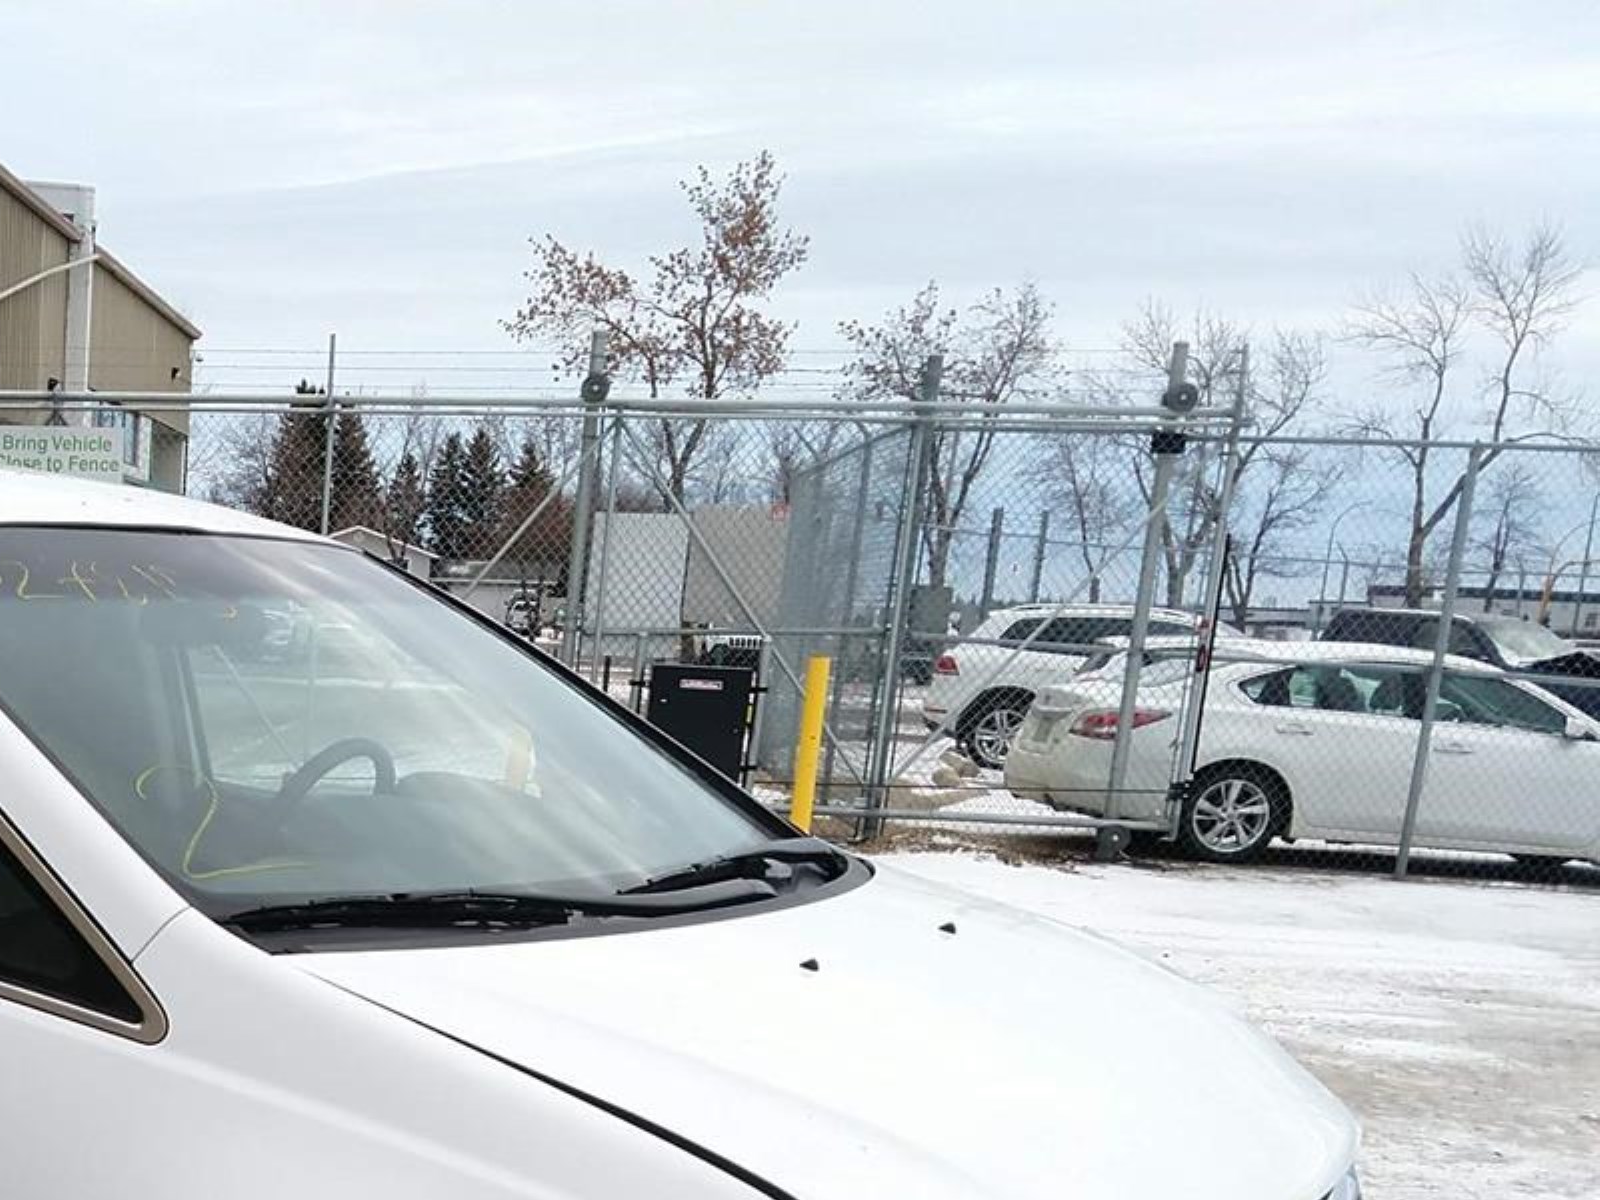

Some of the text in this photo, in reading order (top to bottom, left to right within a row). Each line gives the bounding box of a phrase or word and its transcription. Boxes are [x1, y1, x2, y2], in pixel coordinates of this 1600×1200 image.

[2, 434, 113, 454] Bring Vehicle
[46, 456, 62, 472] to
[68, 455, 120, 472] Fence
